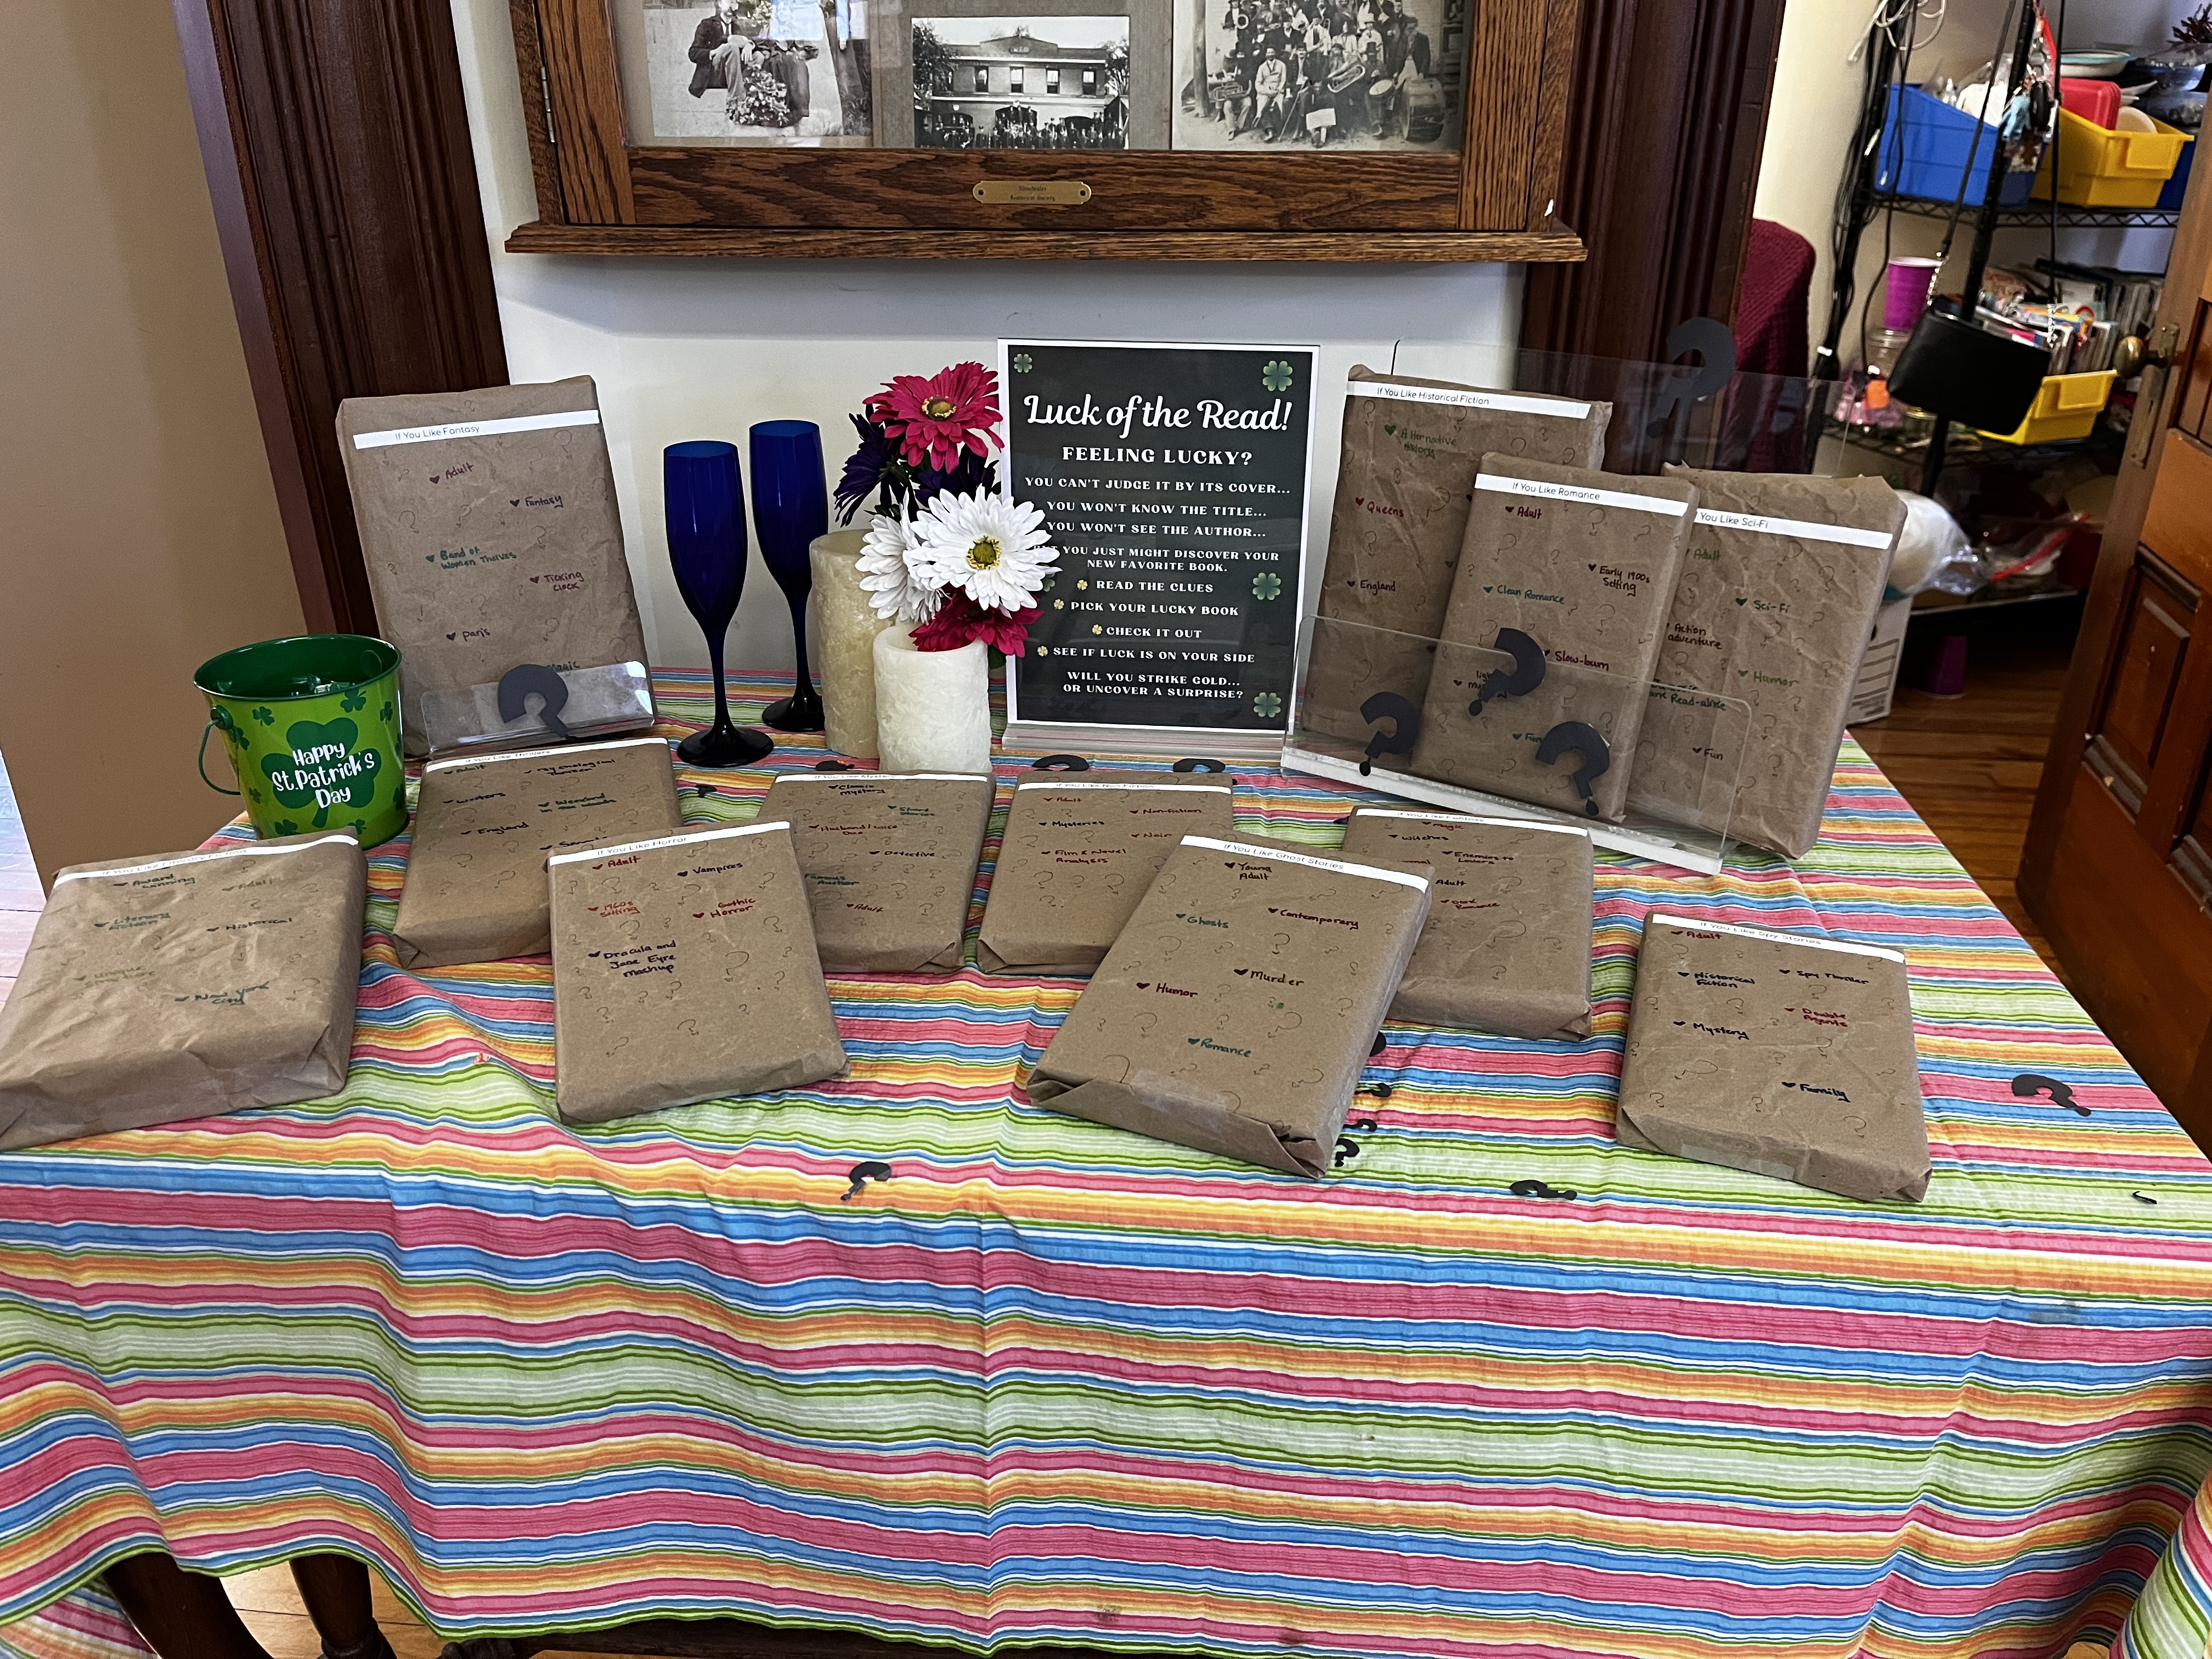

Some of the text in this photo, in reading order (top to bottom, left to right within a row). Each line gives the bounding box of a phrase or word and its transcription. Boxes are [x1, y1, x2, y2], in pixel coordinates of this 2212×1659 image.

[1385, 388, 1398, 397] You
[1401, 390, 1417, 398] Like
[1419, 392, 1459, 402] Historical
[1460, 395, 1489, 405] Fiction
[1023, 394, 1293, 439] Luck of the Read!
[443, 426, 479, 435] Fantasy
[1063, 447, 1252, 466] FEELING LUCKY?
[445, 462, 473, 479] Adult
[1025, 477, 1290, 494] YOU CAN'T JUDGE IT BY ITS COVER...
[1521, 483, 1536, 493] You
[1539, 485, 1556, 494] Like
[1559, 488, 1600, 500] Romance
[525, 495, 563, 509] Fantasy
[1047, 501, 1267, 516] YOU WON'T KNOW THE TITLE...
[1367, 501, 1404, 517] Queens
[1517, 506, 1542, 519] Adult
[1701, 512, 1768, 528] You Like Sci-Fi
[1047, 522, 1266, 538] YOU WON'T SEE THE AUTHOR...
[440, 548, 466, 561] Band
[1063, 546, 1088, 555] YOU
[1092, 547, 1125, 556] JUST
[1129, 549, 1170, 558] MIGHT
[1175, 549, 1239, 560] DISCOVER
[1244, 551, 1279, 561] YOUR
[1694, 549, 1720, 560] Adult
[1087, 560, 1228, 572] NEW FAVORITE BOOK.
[1600, 566, 1622, 582] Early
[1097, 580, 1214, 592] READ THE CLUES
[1360, 579, 1396, 595] England
[1602, 577, 1636, 597] Setting
[1497, 585, 1564, 604] Clean Romance
[1071, 602, 1239, 616] PICK YOUR LUCKY BOOK
[1106, 627, 1202, 638] CHECK IT OUT
[1674, 623, 1706, 636] Action
[1668, 634, 1723, 650] adventure
[1053, 647, 1255, 663] SEE IF LUCK IS ON YOUR SIDE
[1067, 672, 1240, 686] WILL YOU STRIKE GOLD...
[1753, 672, 1799, 687] Humor
[1063, 684, 1244, 699] OR UNCOVER A SURPRISE?
[292, 743, 345, 766] Happy
[1704, 748, 1723, 760] Fun
[315, 787, 351, 809] Day
[477, 822, 529, 834] England
[653, 837, 688, 847] Horror
[607, 855, 641, 867] Adult
[1233, 844, 1250, 853] You
[1253, 848, 1273, 856] Like
[1276, 852, 1305, 862] Ghost
[1308, 858, 1344, 870] Stories
[692, 862, 743, 874] Vampires
[1238, 862, 1272, 872] Young
[1239, 872, 1268, 880] Adult
[710, 905, 753, 918] Horror
[854, 904, 883, 912] Adult
[1187, 916, 1229, 928] Ghosts
[1280, 909, 1359, 930] Contemporary
[1686, 931, 1723, 939] Adult
[1781, 934, 1821, 945] Stories
[603, 940, 676, 959] Dracula and
[610, 954, 676, 969] Jane Eyre
[1155, 983, 1198, 997] Humor
[1693, 1023, 1750, 1040] Mystery
[1200, 1038, 1251, 1058] Romance
[1800, 1084, 1850, 1103] Family
